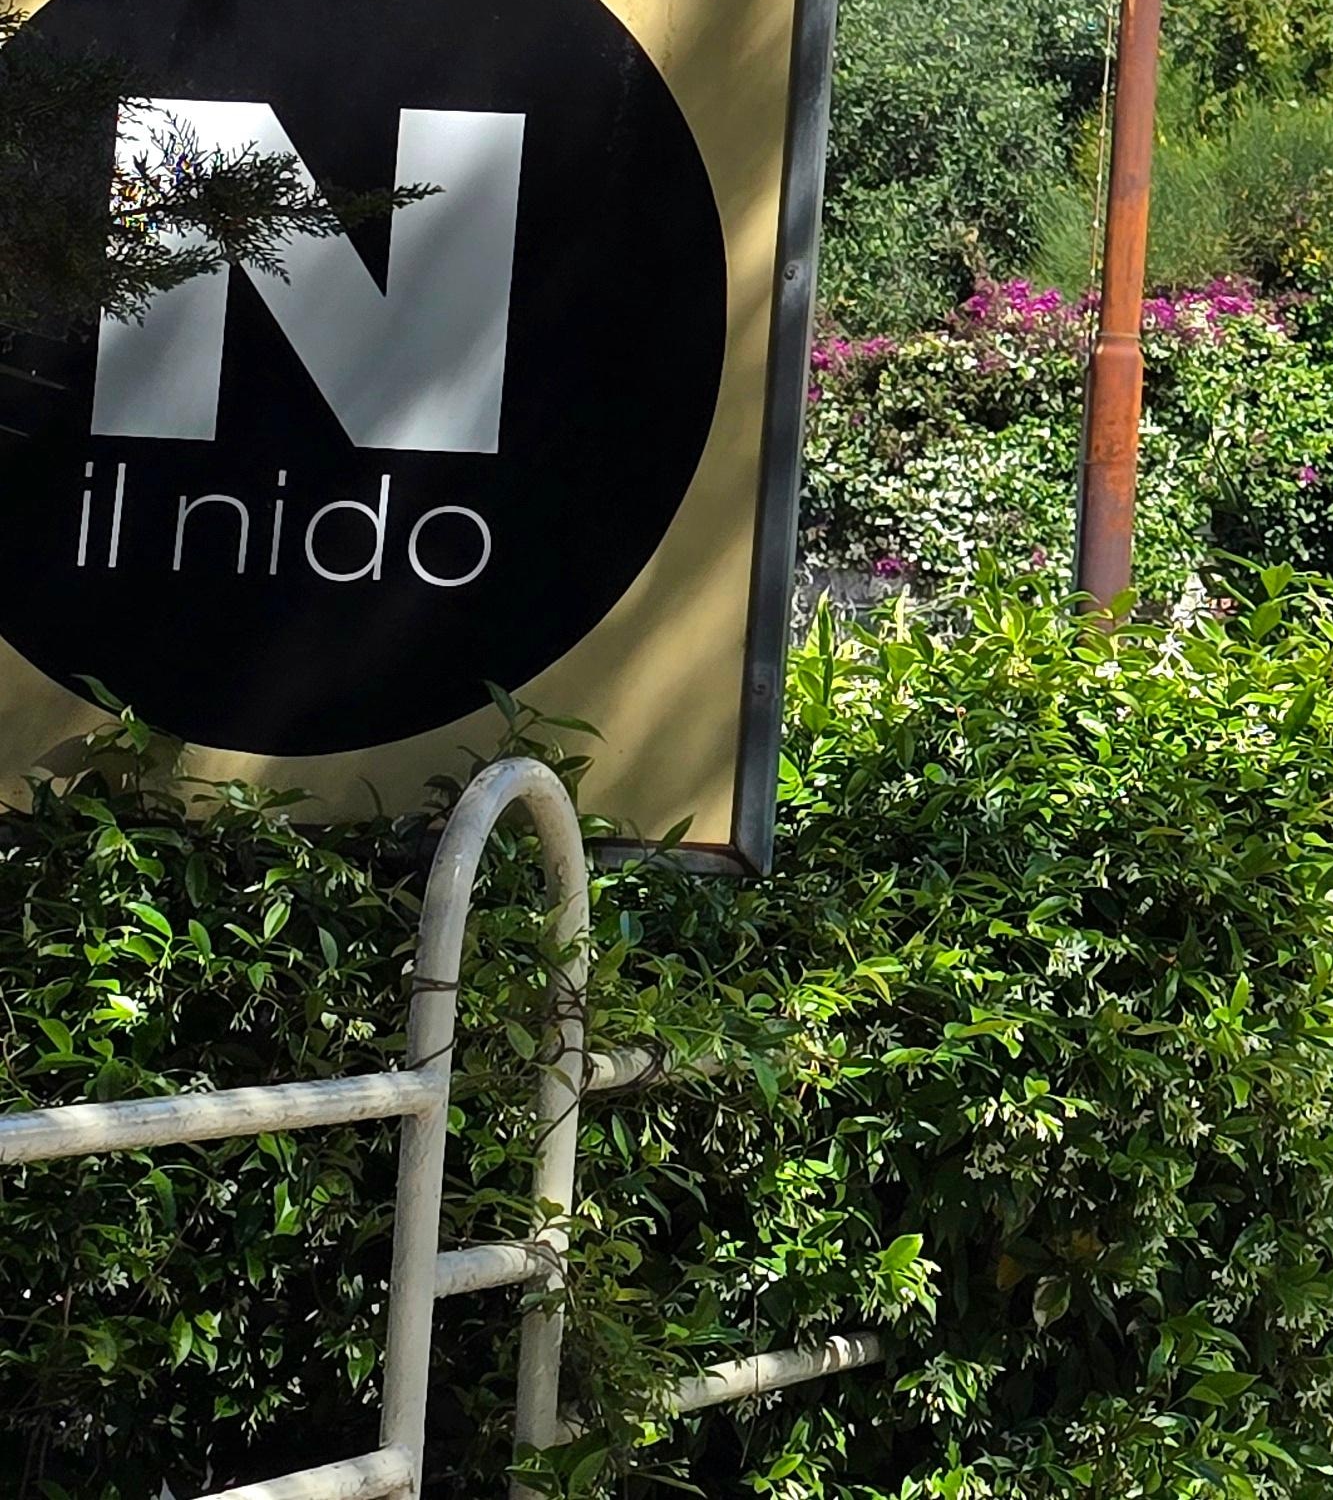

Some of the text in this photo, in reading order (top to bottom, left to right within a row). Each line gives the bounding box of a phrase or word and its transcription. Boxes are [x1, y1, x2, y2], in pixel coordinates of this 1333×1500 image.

[90, 96, 527, 454] N
[77, 461, 493, 588] il nido
